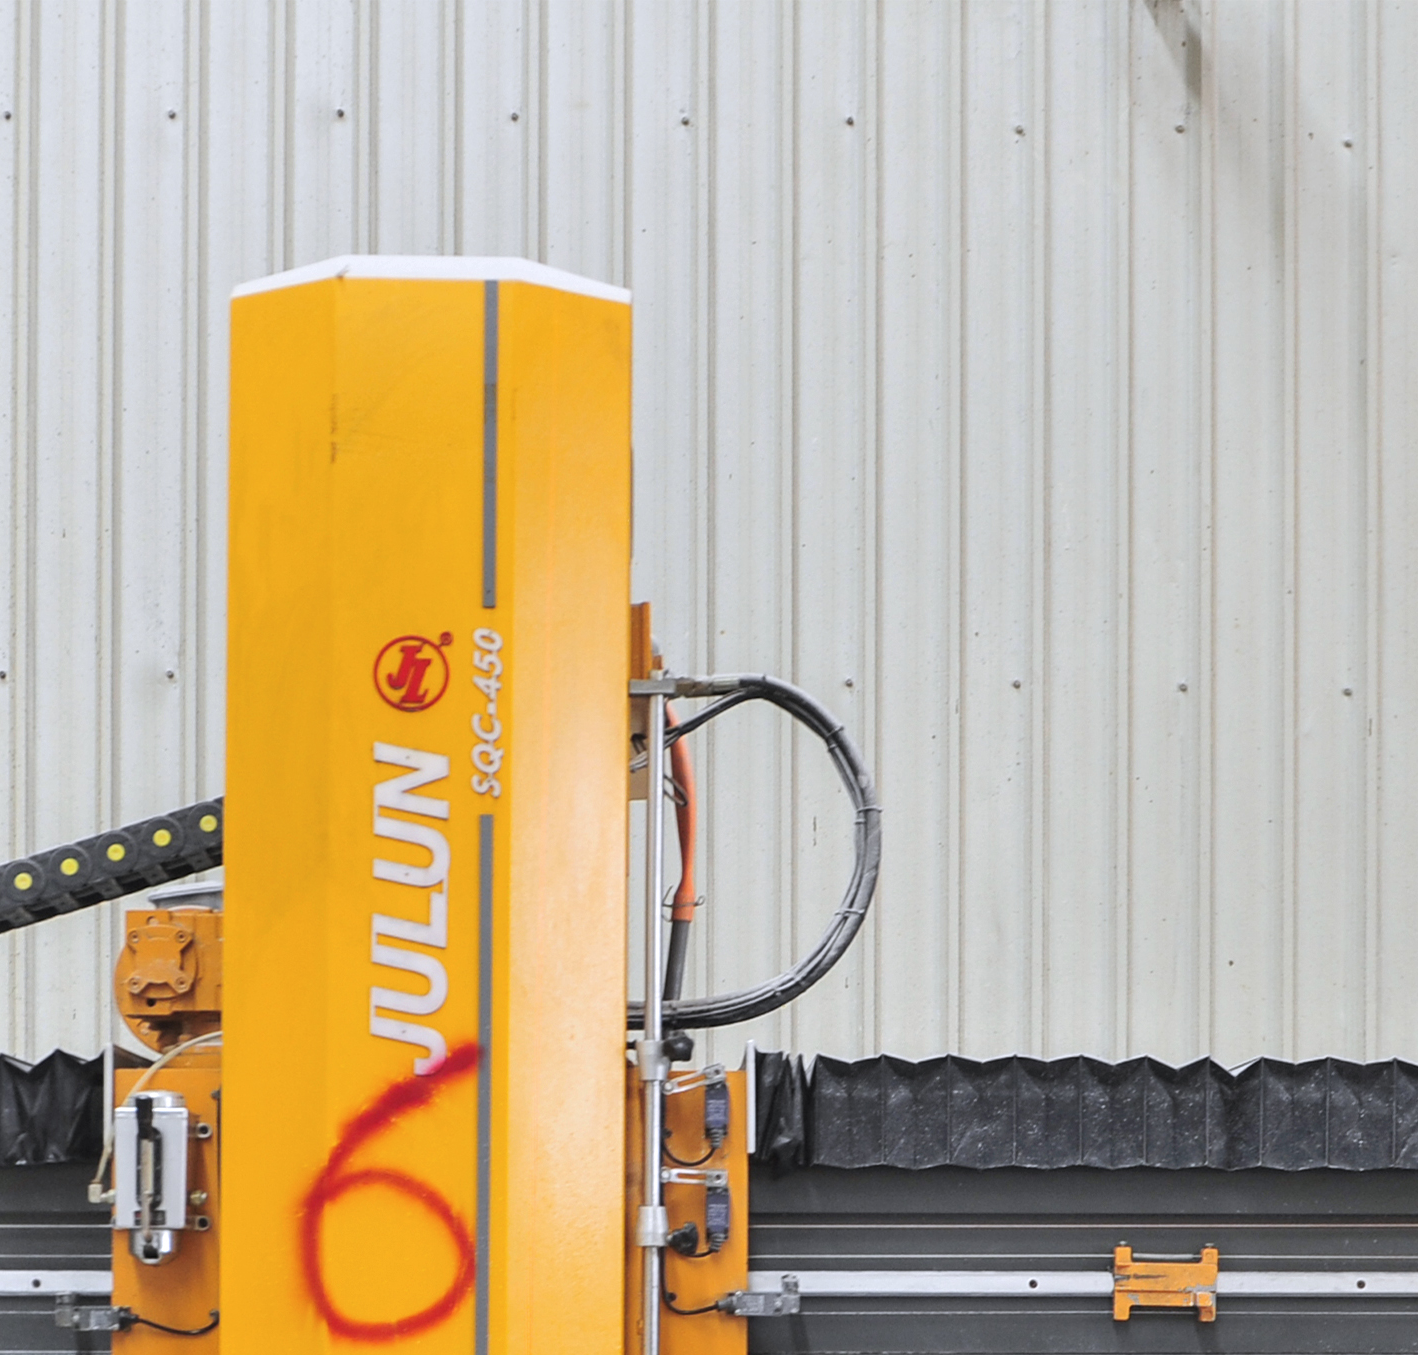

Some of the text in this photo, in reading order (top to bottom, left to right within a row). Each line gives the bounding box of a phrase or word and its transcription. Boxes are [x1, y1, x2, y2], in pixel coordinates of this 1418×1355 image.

[471, 627, 504, 798] SQC-450
[370, 742, 450, 1077] JULUN
[298, 1041, 485, 1345] 6
